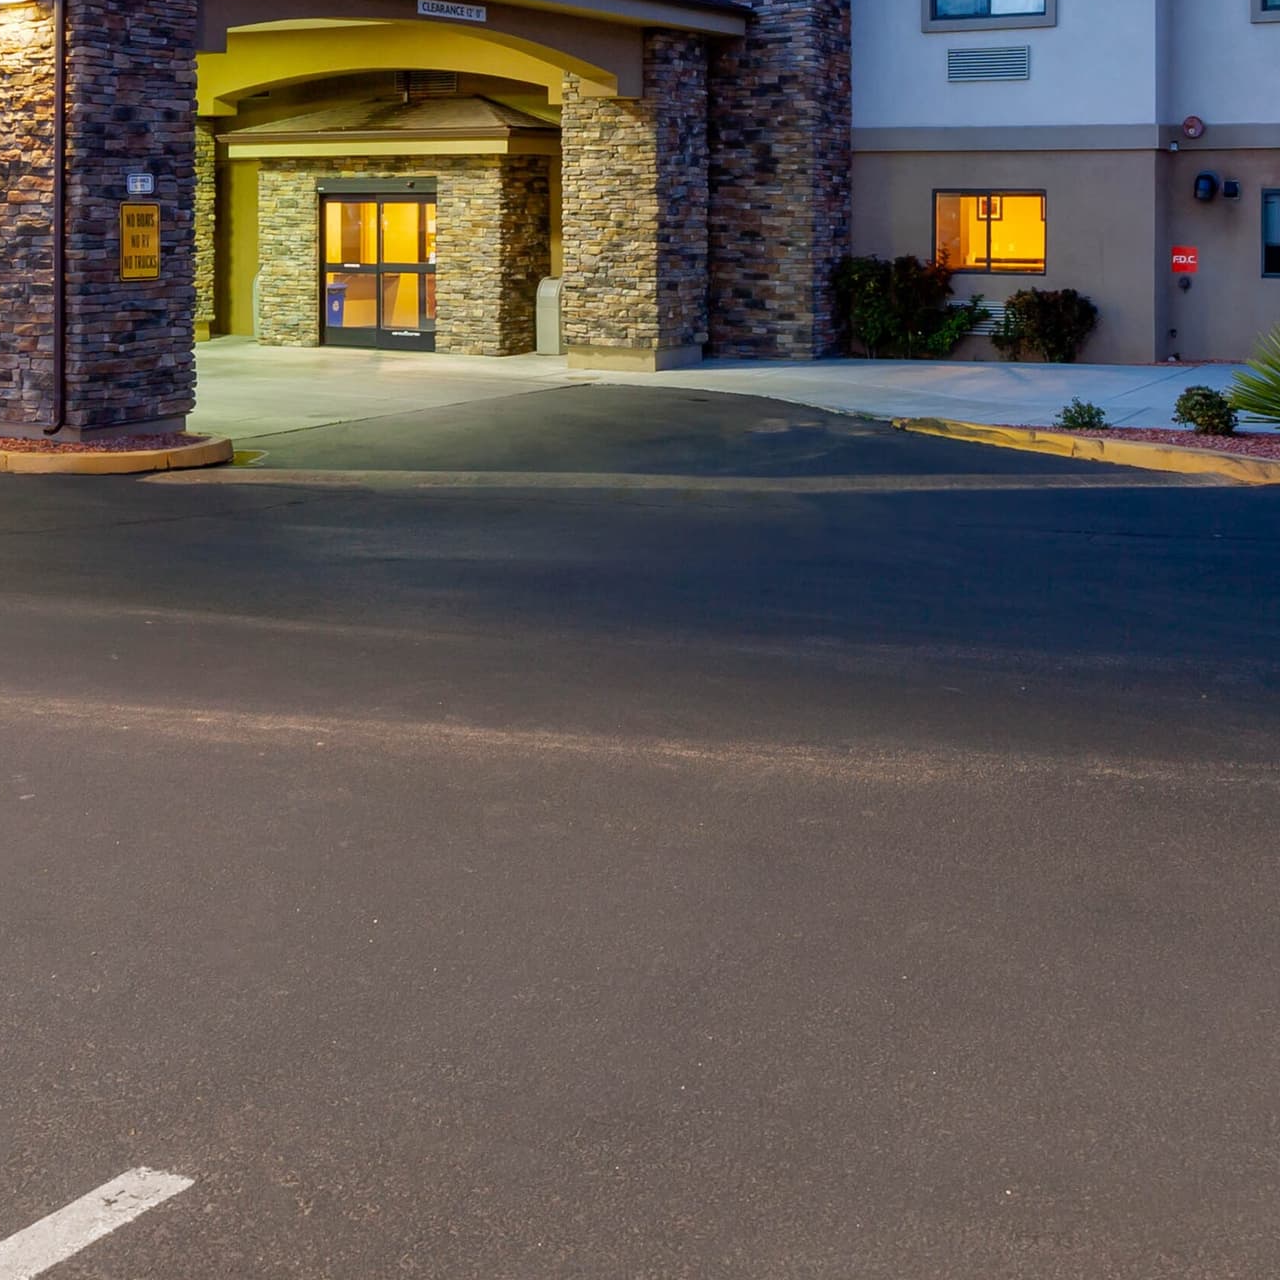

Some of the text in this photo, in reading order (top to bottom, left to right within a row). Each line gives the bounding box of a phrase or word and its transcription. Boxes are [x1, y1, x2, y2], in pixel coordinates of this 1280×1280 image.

[422, 1, 465, 17] CLEARANCE
[126, 213, 135, 227] NO
[131, 234, 140, 248] NO
[124, 255, 157, 269] NO TRUCKS
